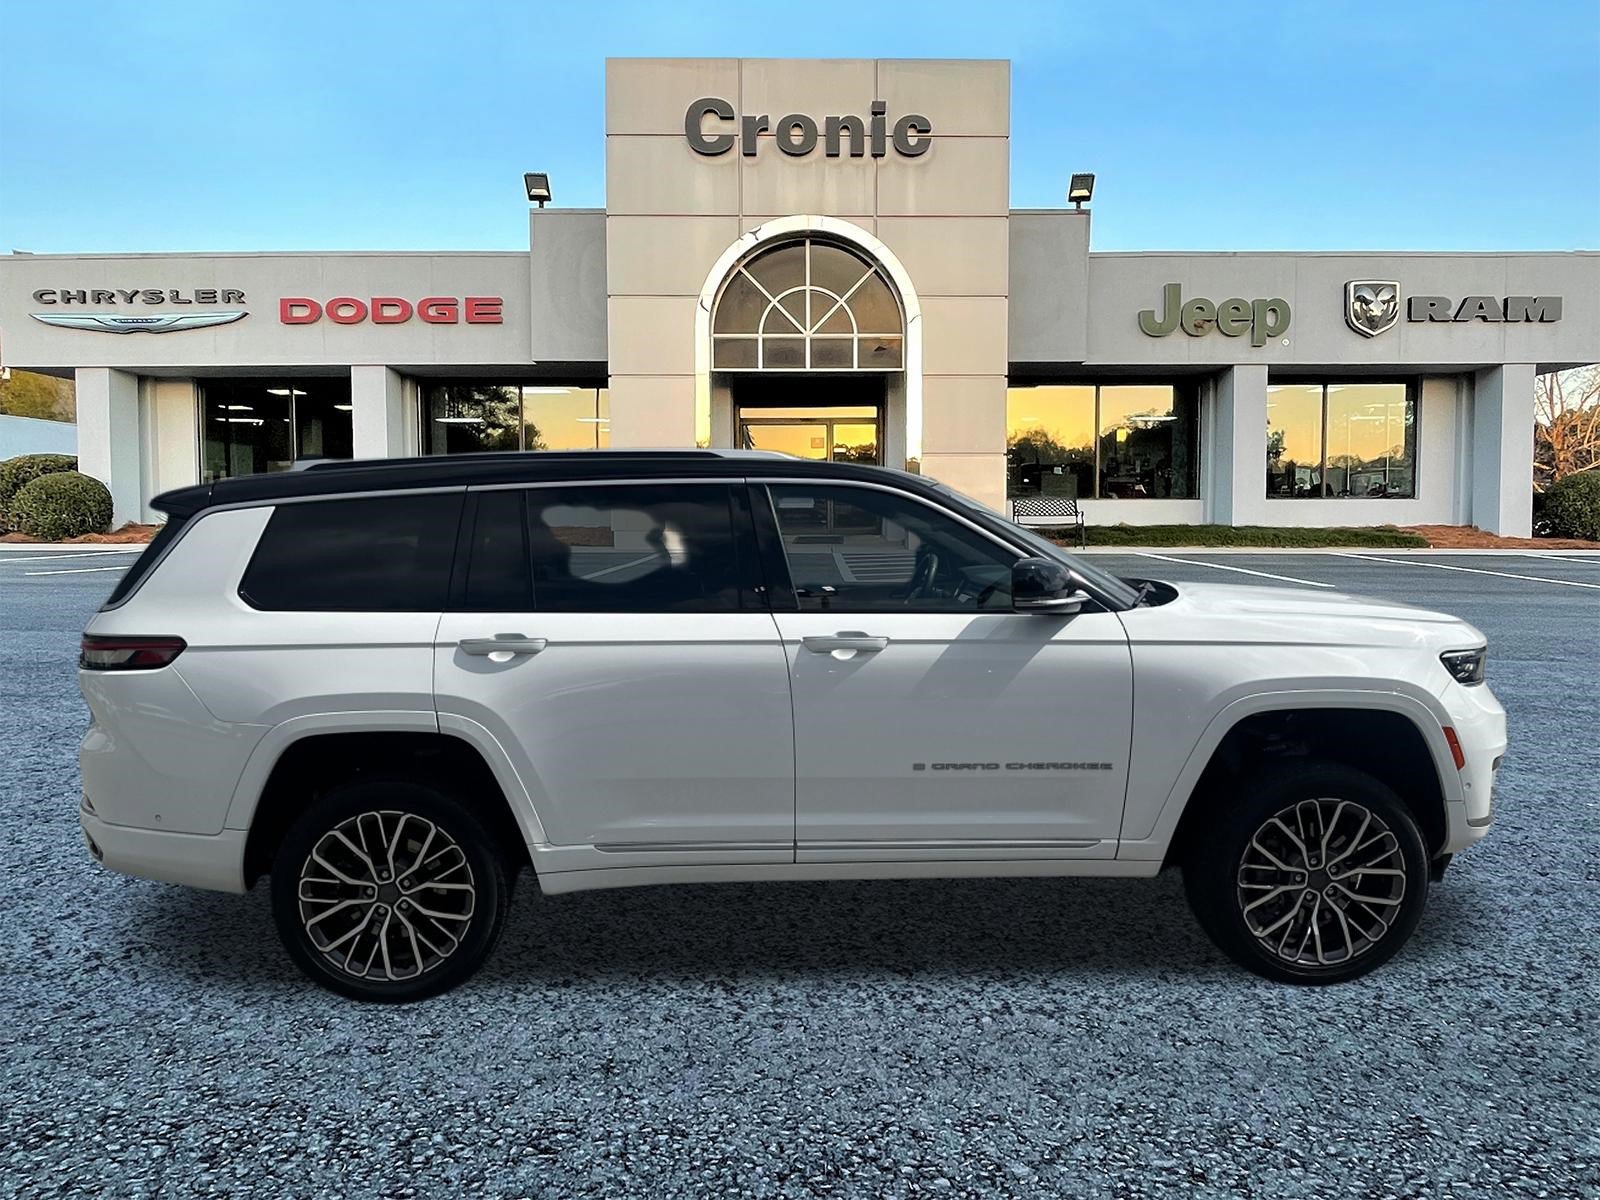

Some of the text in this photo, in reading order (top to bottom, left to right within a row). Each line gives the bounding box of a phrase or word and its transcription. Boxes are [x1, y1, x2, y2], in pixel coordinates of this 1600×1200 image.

[685, 97, 932, 157] Cronic
[32, 288, 247, 305] CHRYSLER
[279, 296, 504, 325] DODGE
[1407, 296, 1563, 323] RAM
[1138, 283, 1291, 347] Jeep
[931, 762, 1113, 770] GRAND CHEROKEE
